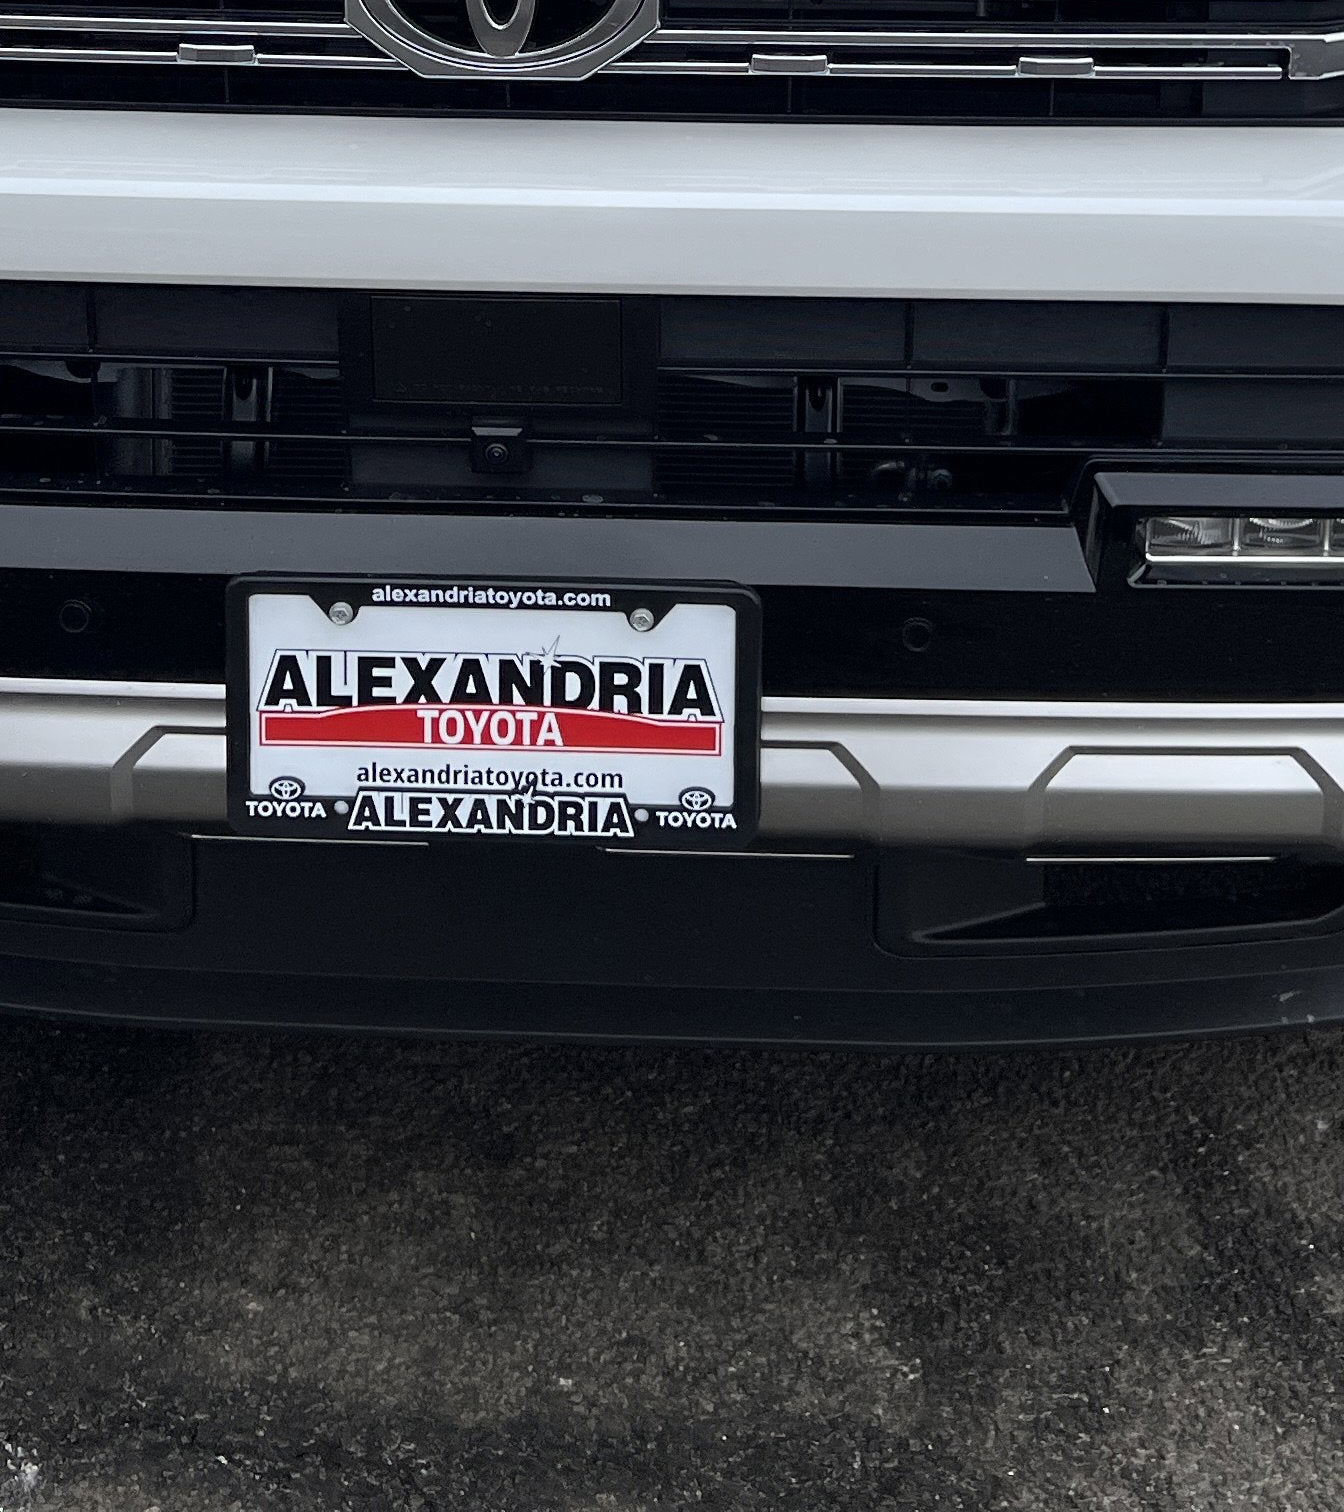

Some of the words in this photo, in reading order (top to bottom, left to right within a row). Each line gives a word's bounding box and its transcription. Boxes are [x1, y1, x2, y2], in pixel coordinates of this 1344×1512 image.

[371, 585, 611, 608] alexandriatoyota.com
[263, 653, 717, 717] ALEXANDRIA
[416, 709, 565, 747] TOYOTA
[356, 761, 624, 790] alexandriatoyota.com
[245, 800, 327, 819] TOYOTA
[350, 793, 630, 836] ALEXANDRIA
[655, 810, 737, 829] TOYOTA
